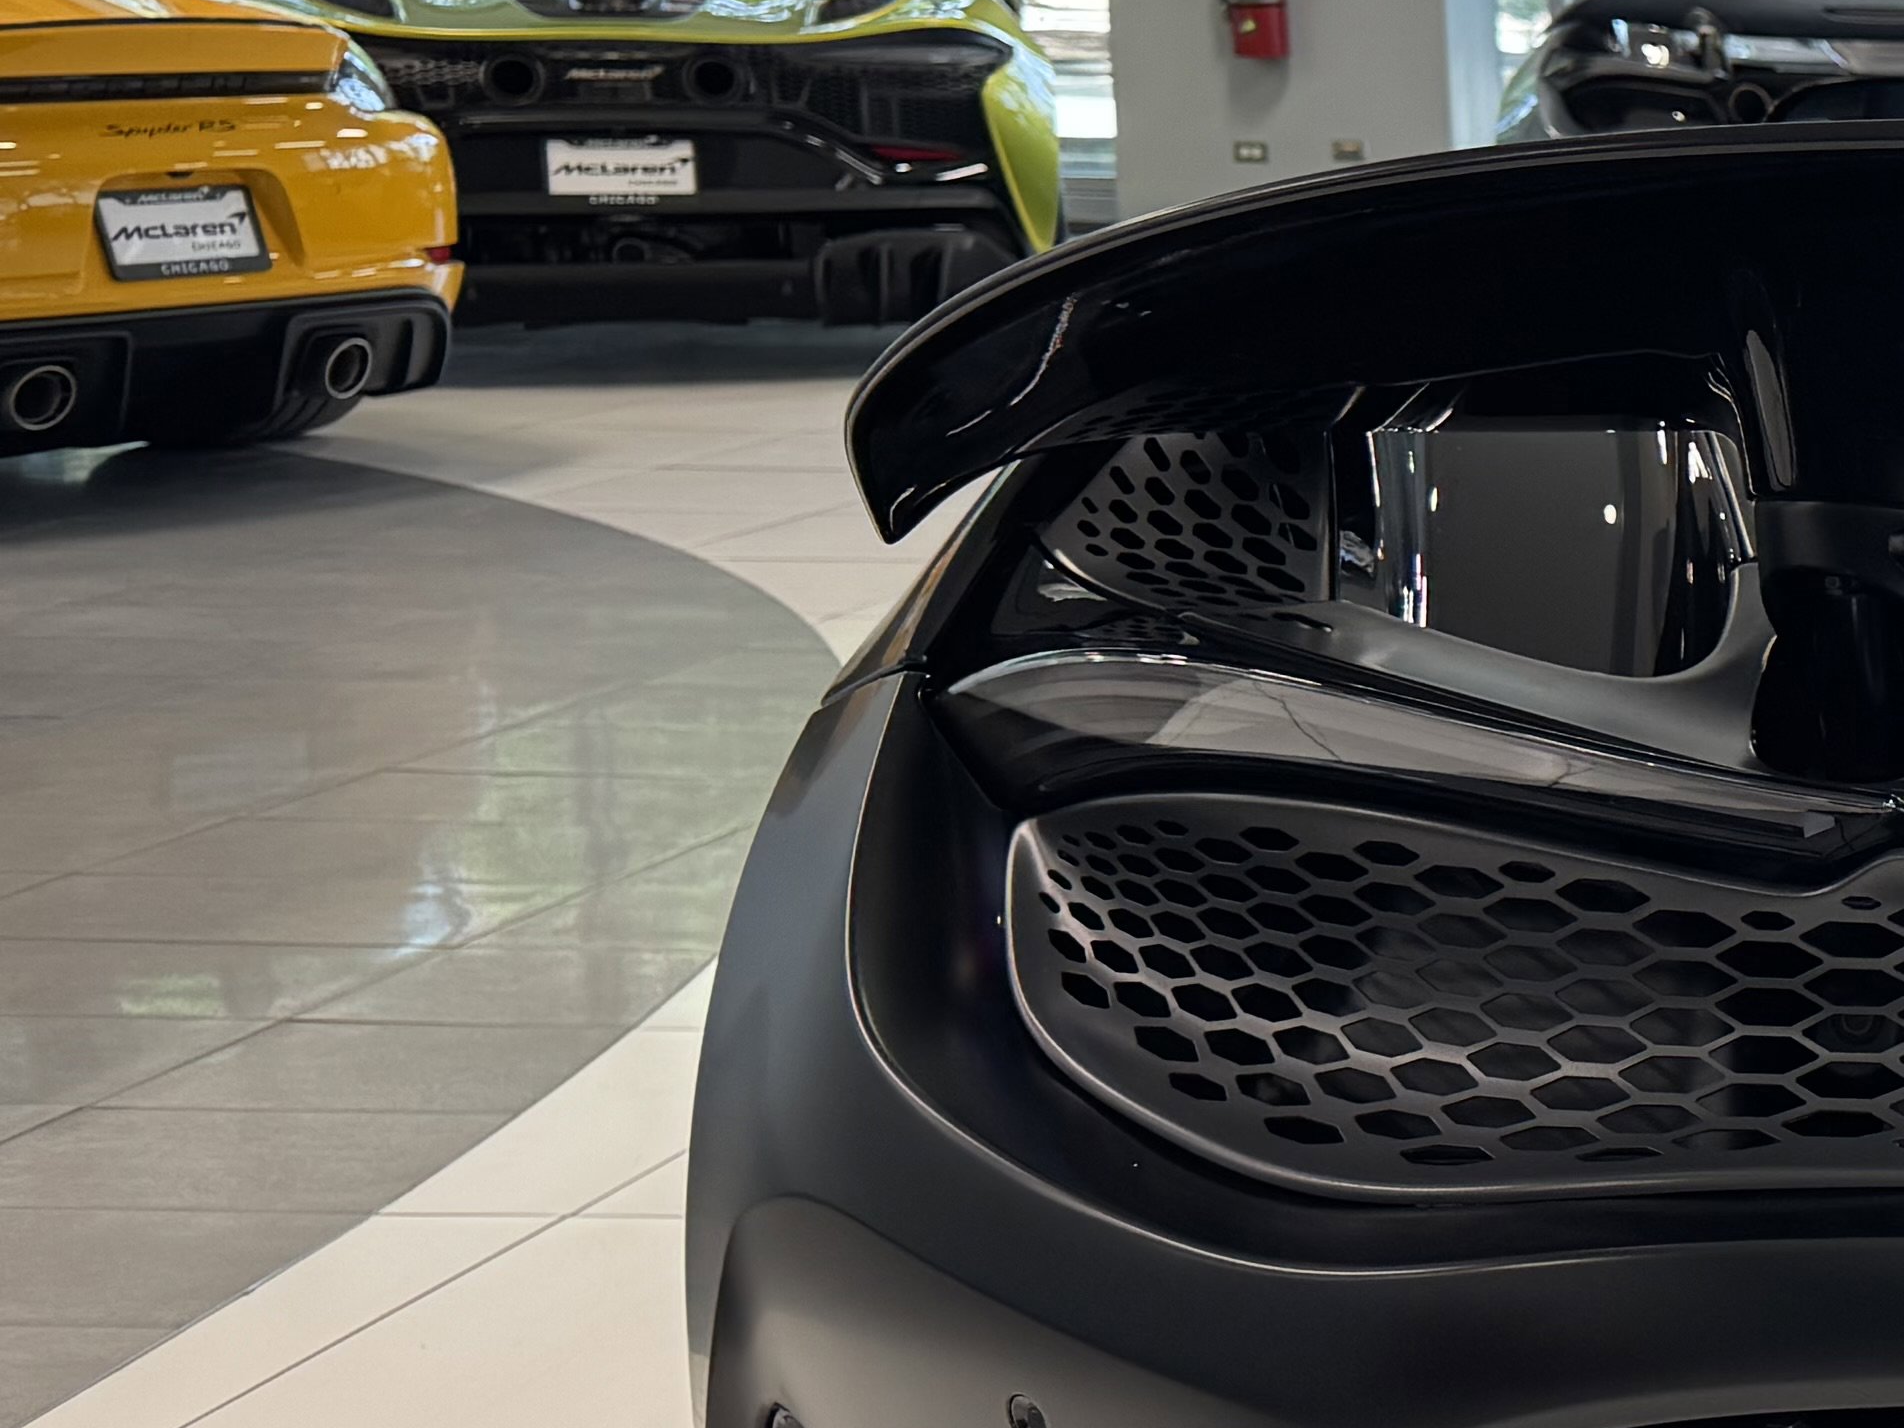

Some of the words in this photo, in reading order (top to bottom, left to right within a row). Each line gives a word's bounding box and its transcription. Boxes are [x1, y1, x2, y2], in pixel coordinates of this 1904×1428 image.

[553, 162, 677, 176] McLaren
[112, 222, 237, 242] McLaren
[160, 259, 229, 276] CHICAGO
